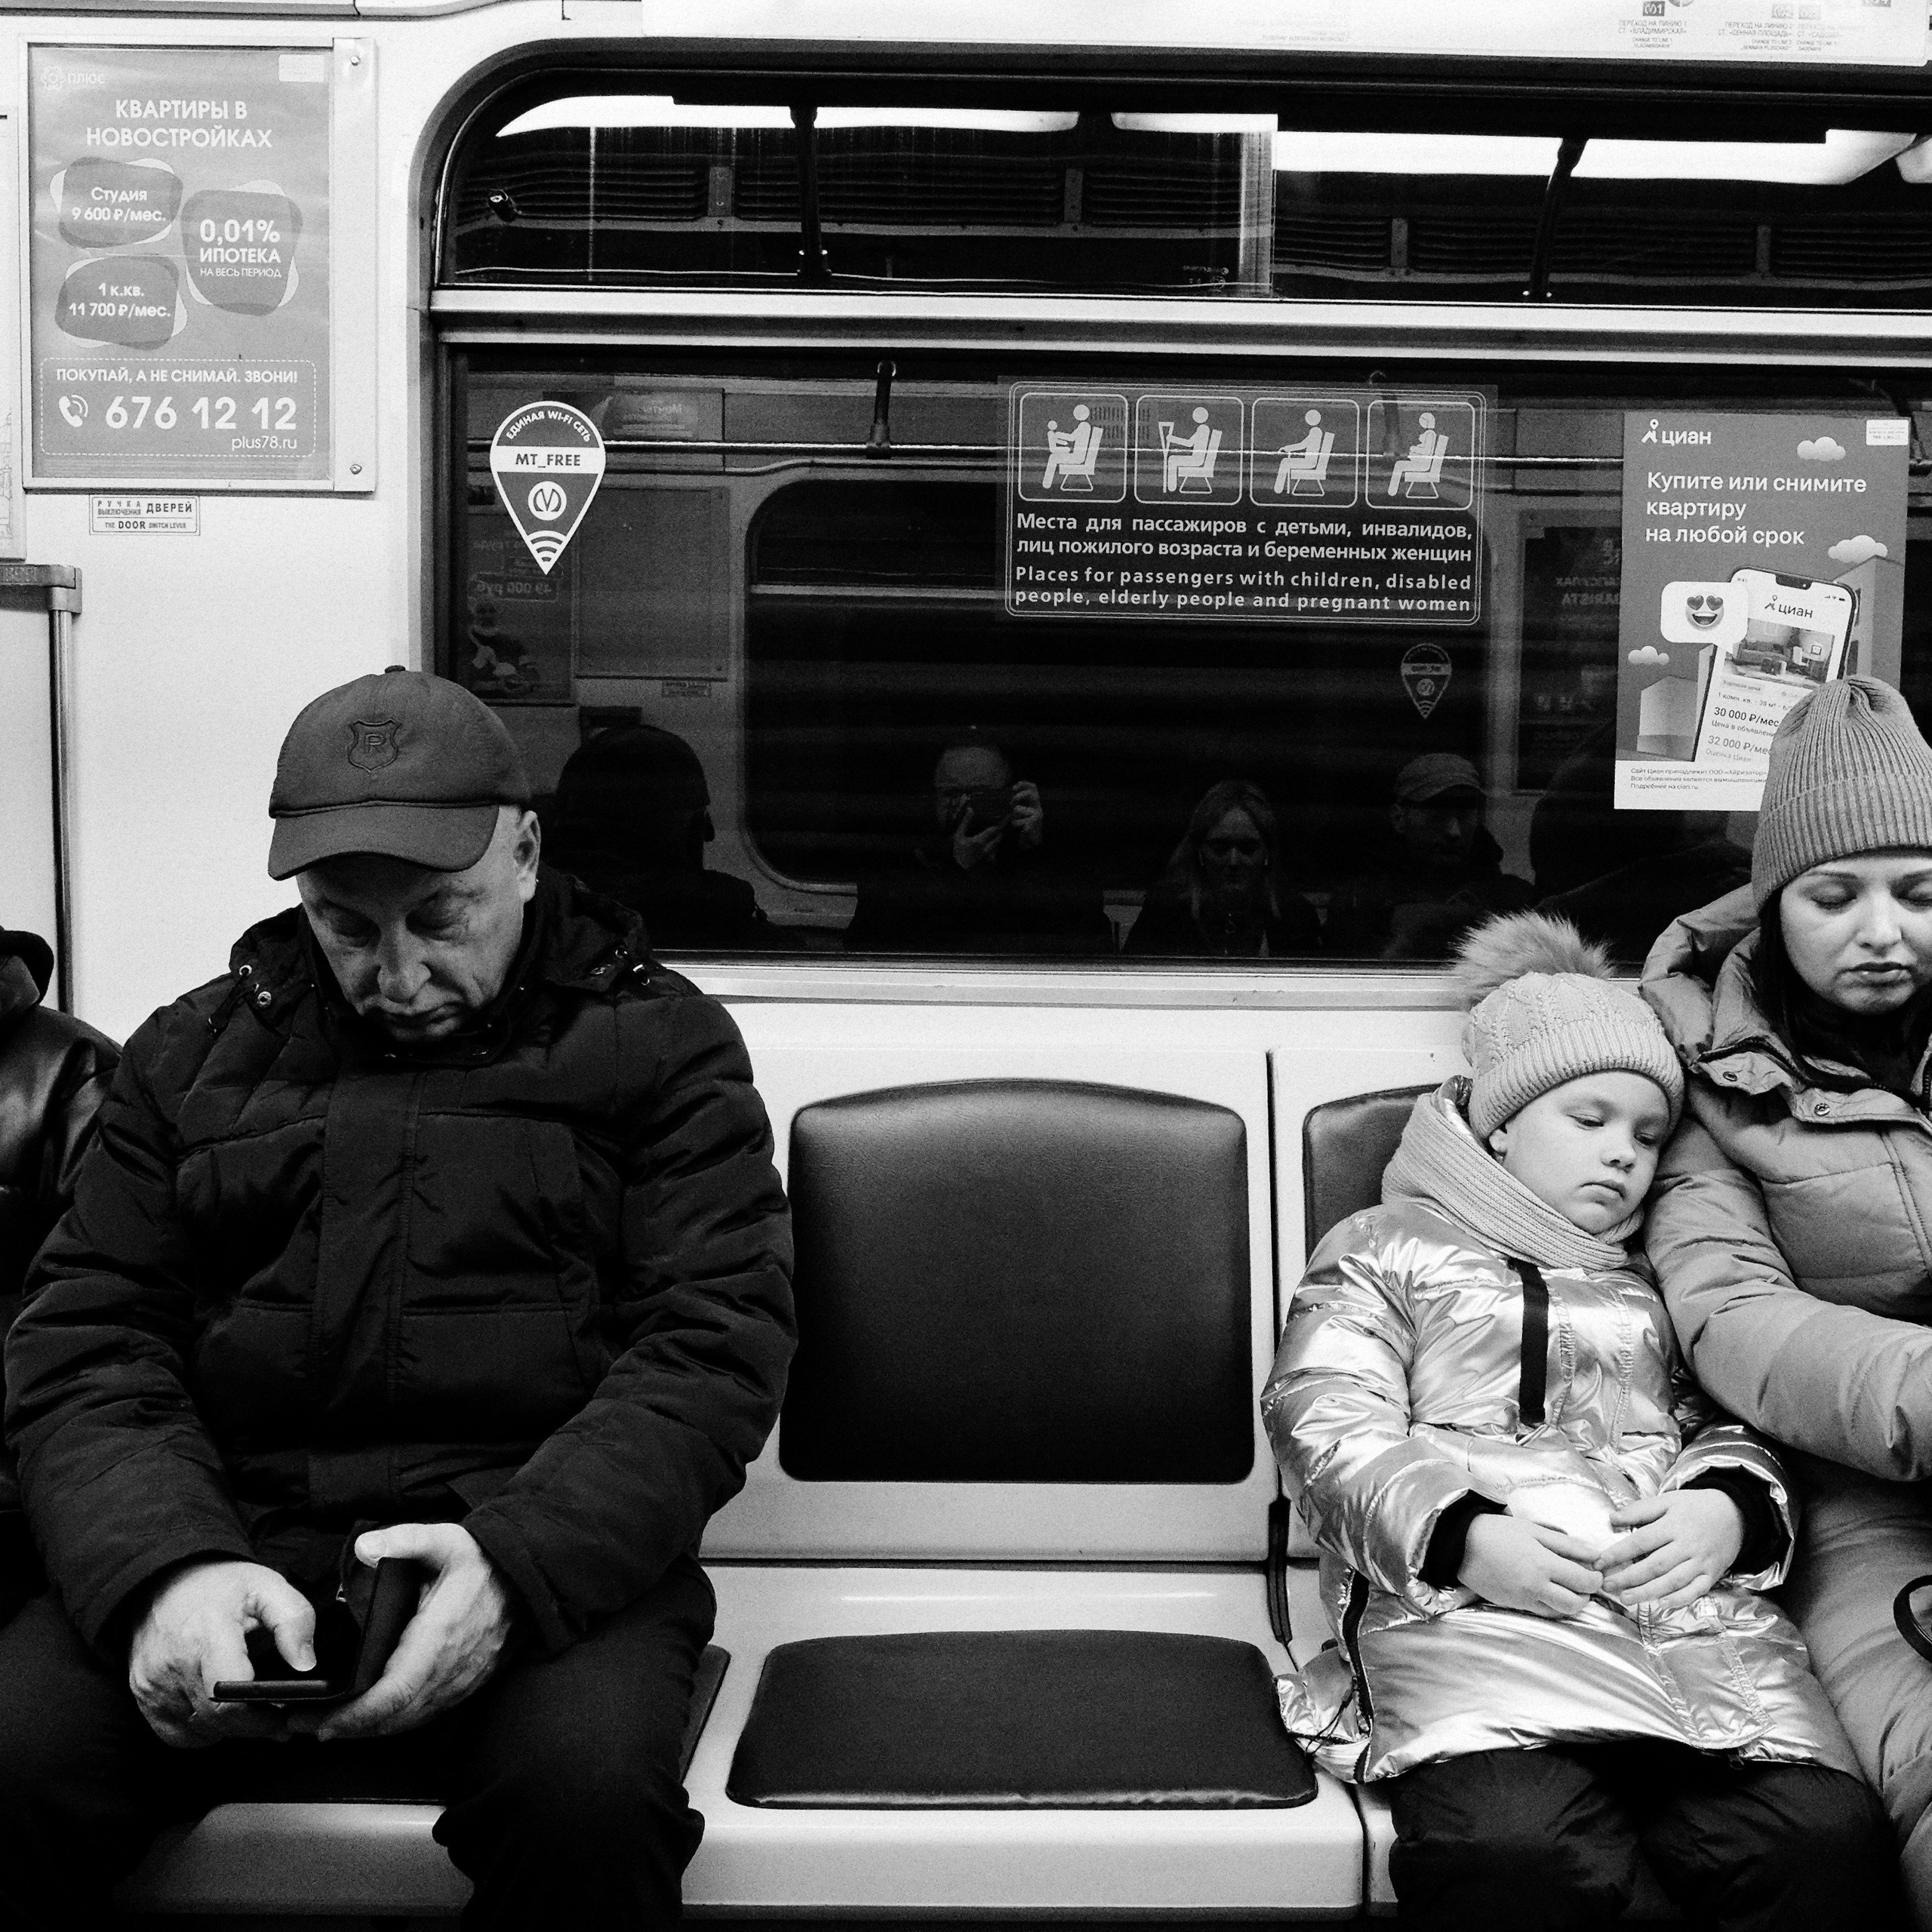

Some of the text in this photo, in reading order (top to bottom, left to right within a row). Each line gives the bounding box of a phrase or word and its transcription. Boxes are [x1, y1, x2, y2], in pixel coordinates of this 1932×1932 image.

[67, 72, 106, 85] ПЛЮС
[115, 99, 248, 120] КВАРТИРЫ В
[86, 125, 272, 148] НОВОСТРОЙКАХ
[91, 186, 148, 204] Студия
[199, 219, 281, 245] 0,01%
[199, 248, 281, 263] ИПОТЕКА
[200, 267, 281, 278] НА ВЕСЬ ПЕРИОД
[99, 283, 106, 296] 1
[69, 303, 85, 316] 11
[89, 303, 115, 317] 700
[57, 366, 297, 383] ПОКУПАЙ, А НЕ СНИМАЙ. ЗВОНИ!
[106, 396, 297, 430] 676 12 12
[506, 410, 591, 442] ЕДИНАЯ WI-FI СЕТЬ
[232, 435, 297, 451] plus78.ru
[1662, 429, 1712, 446] циан
[515, 454, 581, 469] MT_FREE
[1647, 472, 1867, 493] Купите или снимите
[146, 501, 192, 514] ДВЕРЕЙ
[1647, 500, 1746, 520] квартиру
[118, 521, 146, 529] DOOR
[1017, 512, 1472, 540] Места для пассажиров с детьми, инвалидов,
[1645, 525, 1804, 548] на любой срок
[1017, 540, 1472, 565] лиц пожилого возраста и беременных женщин
[1016, 567, 1471, 590] Places for passengers with children, disabled
[1015, 588, 1471, 614] people, elderly people and pregnant women
[1778, 603, 1814, 619] циан
[1714, 706, 1726, 717] 30
[1728, 709, 1746, 721] 000
[1712, 720, 1730, 730] Цена
[1737, 725, 1774, 737] объявлени
[1708, 735, 1720, 746] 32
[1723, 739, 1741, 749] 000
[1706, 749, 1732, 758] Оценка
